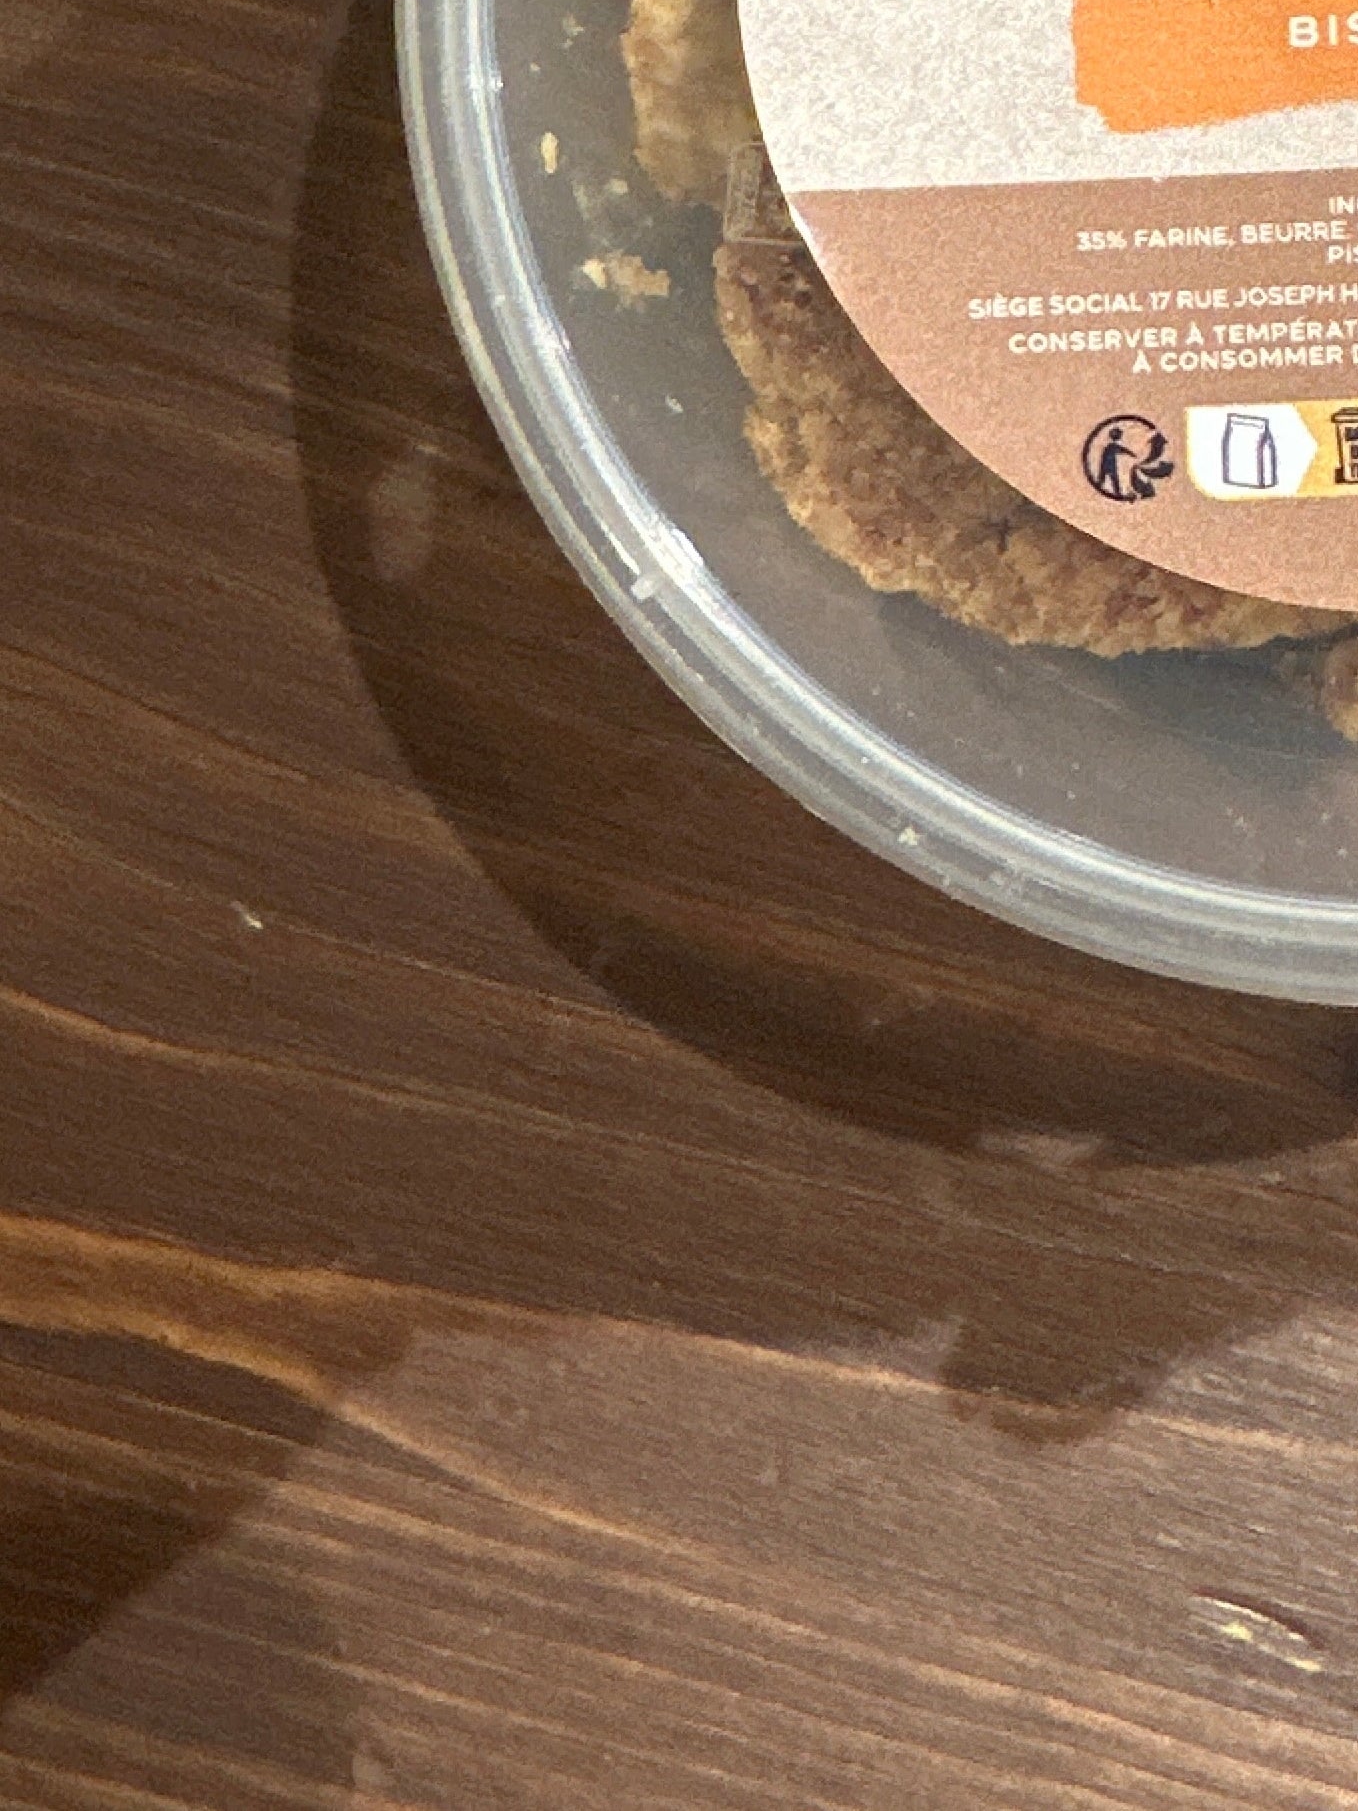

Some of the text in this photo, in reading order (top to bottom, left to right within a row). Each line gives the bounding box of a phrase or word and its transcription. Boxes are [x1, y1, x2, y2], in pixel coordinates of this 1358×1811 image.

[1076, 229, 1126, 251] 35%
[1134, 226, 1235, 248] FARINE,
[968, 292, 1044, 320] SIÈGE
[1050, 292, 1143, 315] SOCIAL
[1149, 292, 1171, 310] 17
[1176, 290, 1229, 310] RUE
[1233, 284, 1334, 307] JOSEPH
[1009, 326, 1177, 353] CONSERVER
[1160, 343, 1343, 373] CONSOMMER
